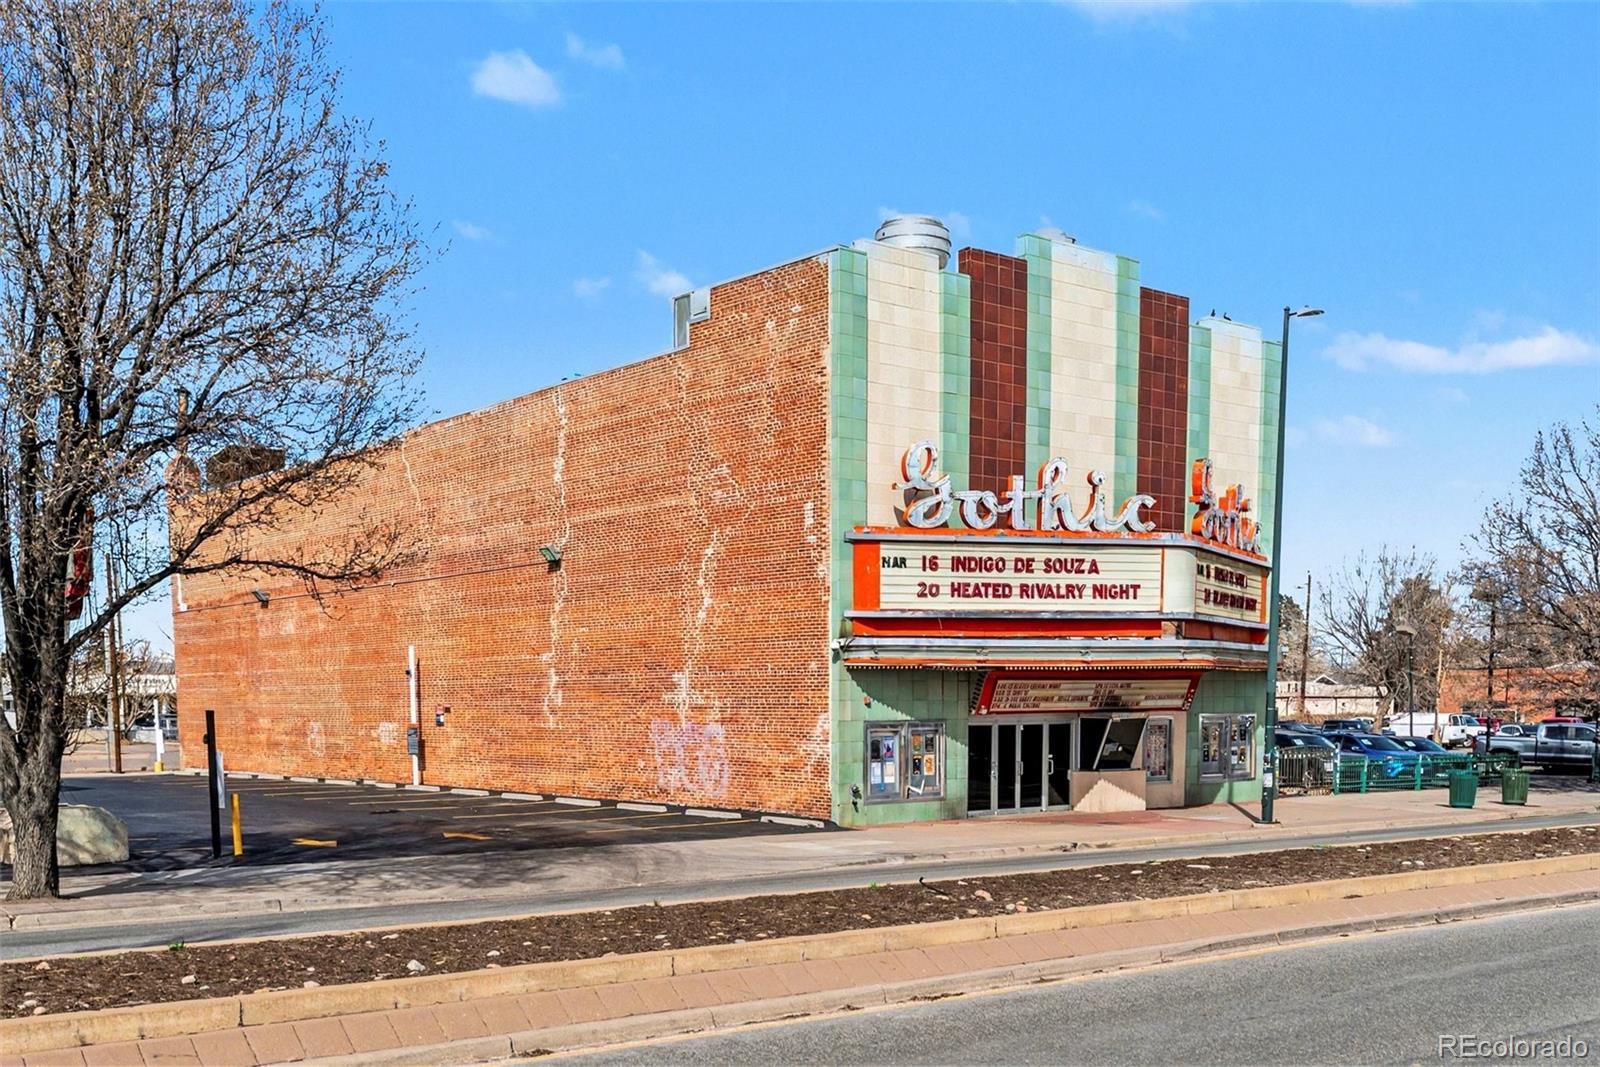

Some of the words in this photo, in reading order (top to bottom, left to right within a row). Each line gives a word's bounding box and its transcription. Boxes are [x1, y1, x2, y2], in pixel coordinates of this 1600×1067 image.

[892, 439, 1157, 533] Gothic
[921, 555, 939, 572] 16
[951, 556, 1006, 573] INDIGO
[1013, 557, 1035, 574] DE
[1043, 557, 1100, 575] SOUZA
[916, 581, 940, 598] 20
[950, 582, 1013, 599] HEATED
[1020, 582, 1087, 600] RIVALRY
[1092, 583, 1141, 600] NIGHT
